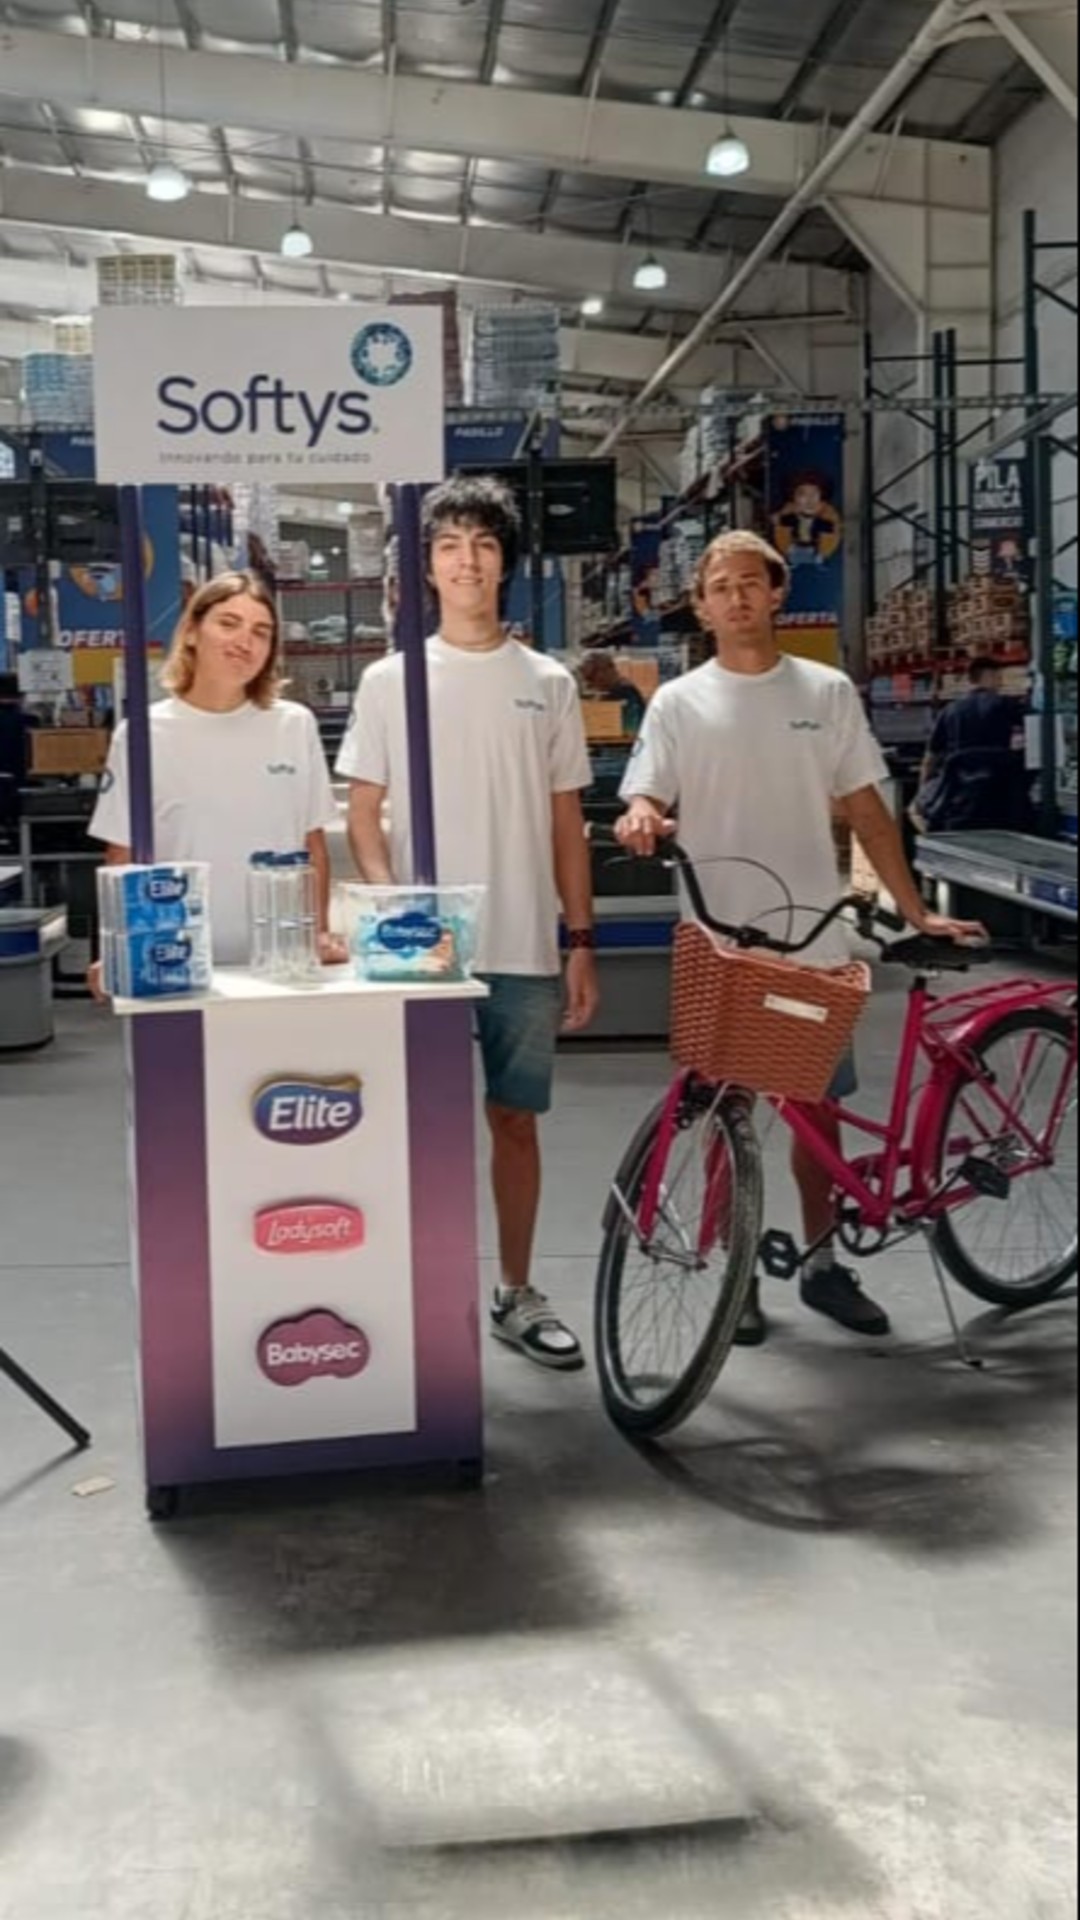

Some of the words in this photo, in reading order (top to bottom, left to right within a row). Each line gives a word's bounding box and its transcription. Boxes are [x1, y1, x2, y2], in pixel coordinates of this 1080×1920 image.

[157, 374, 373, 448] Softys
[159, 452, 242, 464] Innovando
[247, 453, 281, 465] para
[287, 452, 304, 464] tu
[309, 452, 371, 464] cuidado
[268, 1095, 354, 1131] Elite
[266, 1217, 352, 1247] Ladysoft
[266, 1339, 361, 1367] Babysec
